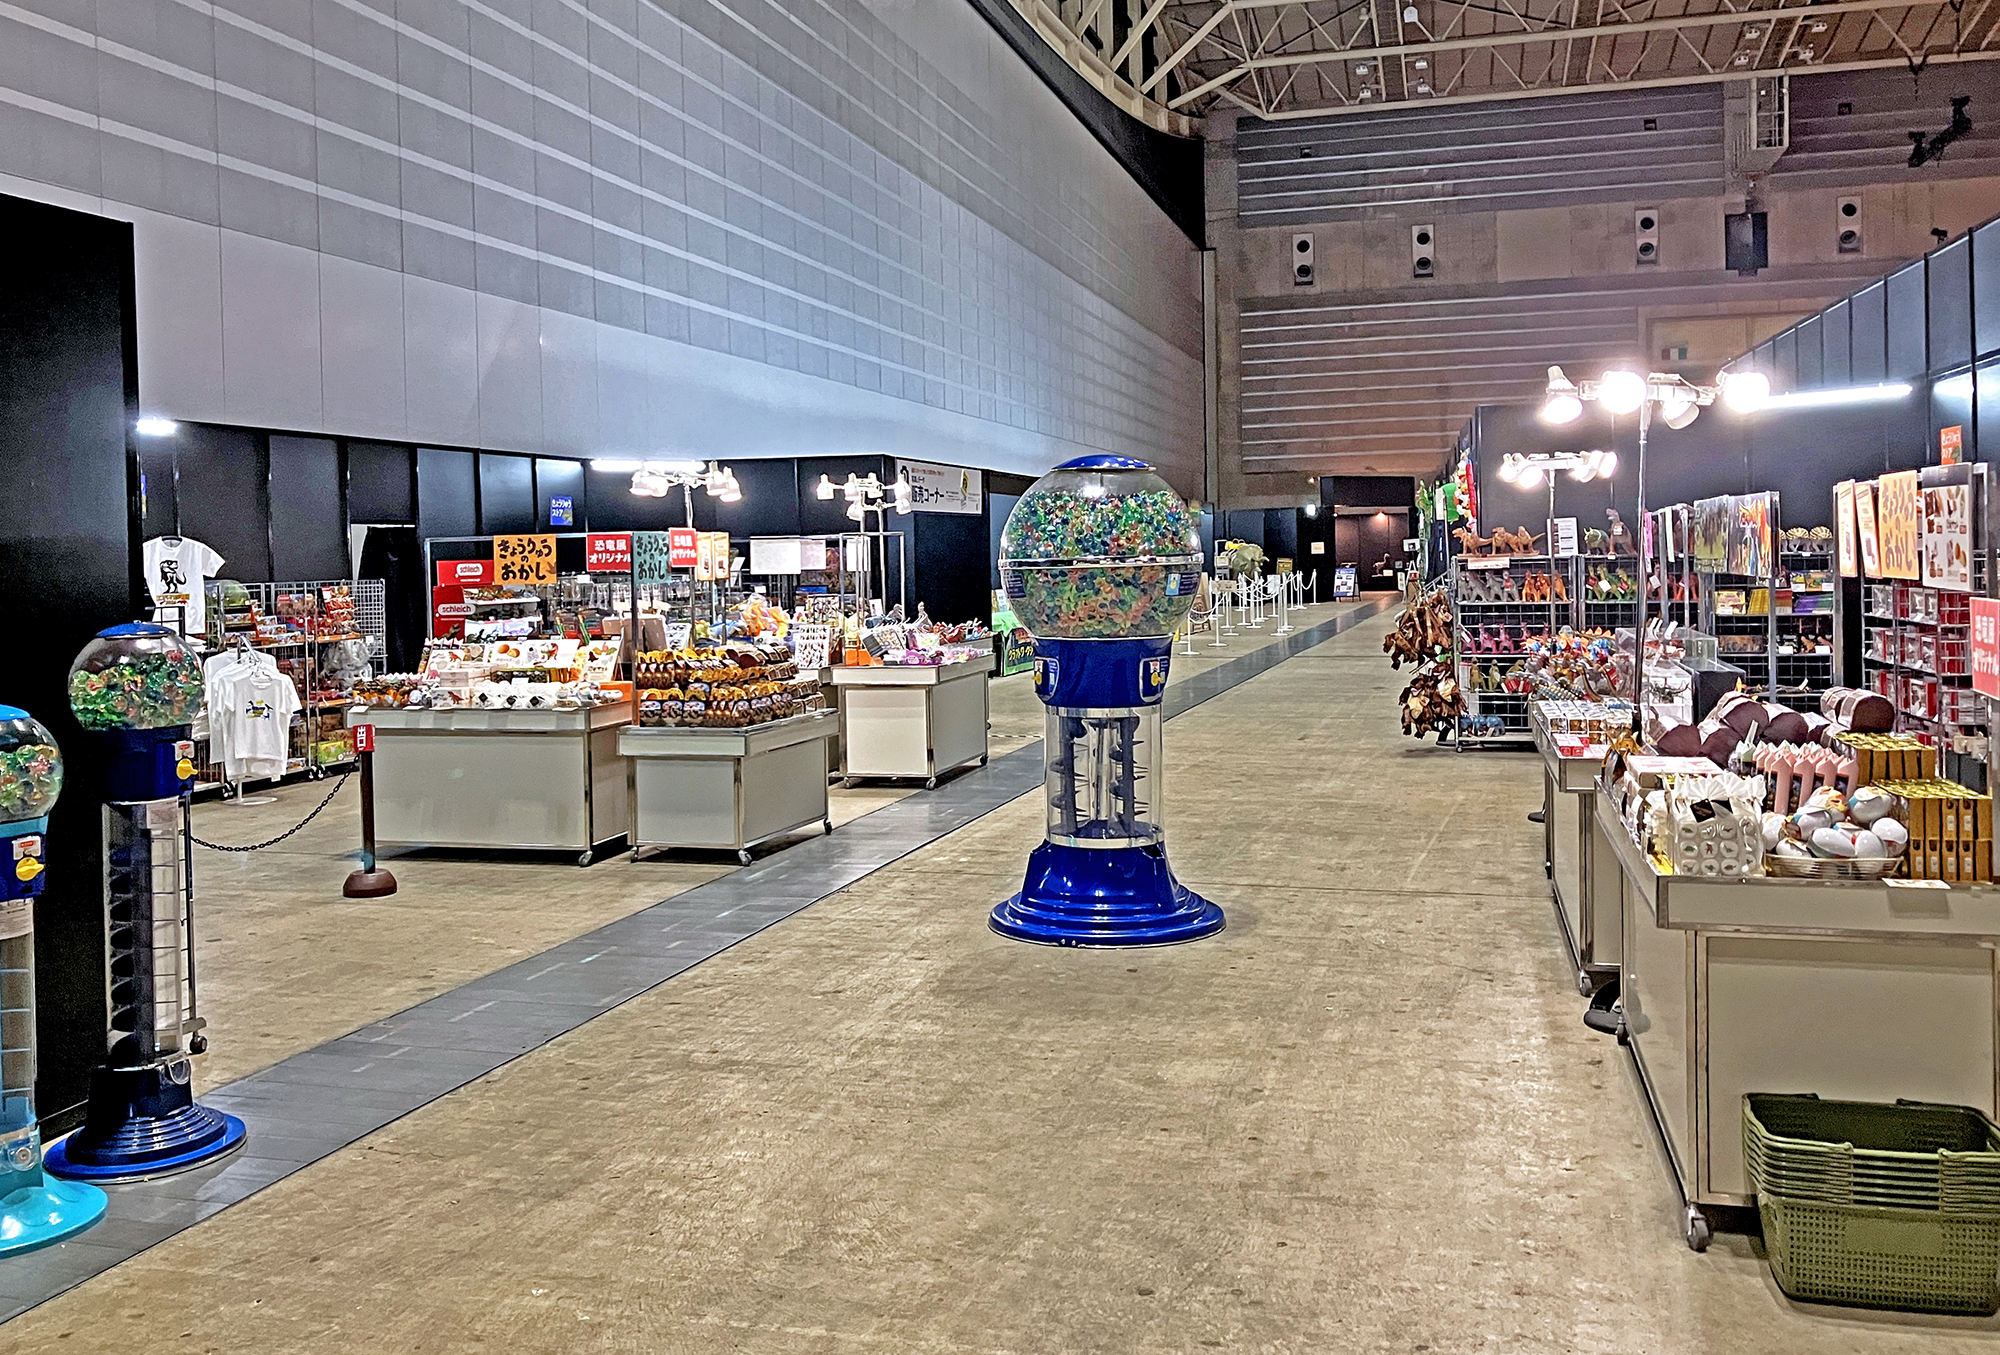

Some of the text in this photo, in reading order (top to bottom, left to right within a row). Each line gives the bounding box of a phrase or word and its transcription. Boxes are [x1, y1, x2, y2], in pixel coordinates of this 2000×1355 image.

[552, 498, 572, 508] きょうりゅう
[1882, 479, 1914, 524] きょうりゅう
[552, 508, 564, 517] ストア
[497, 537, 552, 559] きょうりゅう
[595, 539, 627, 551] 恐竜展
[636, 534, 669, 556] きょうりゅう
[1885, 528, 1912, 572] おかし
[520, 555, 529, 563] の
[589, 553, 631, 564] オリジナル
[649, 553, 655, 561] の
[671, 549, 697, 559] オリジナル
[501, 560, 547, 581] おかし
[638, 559, 665, 580] おかし
[442, 605, 472, 613] schleich
[1973, 646, 1999, 676] オリジナル
[357, 725, 366, 748] 出口
